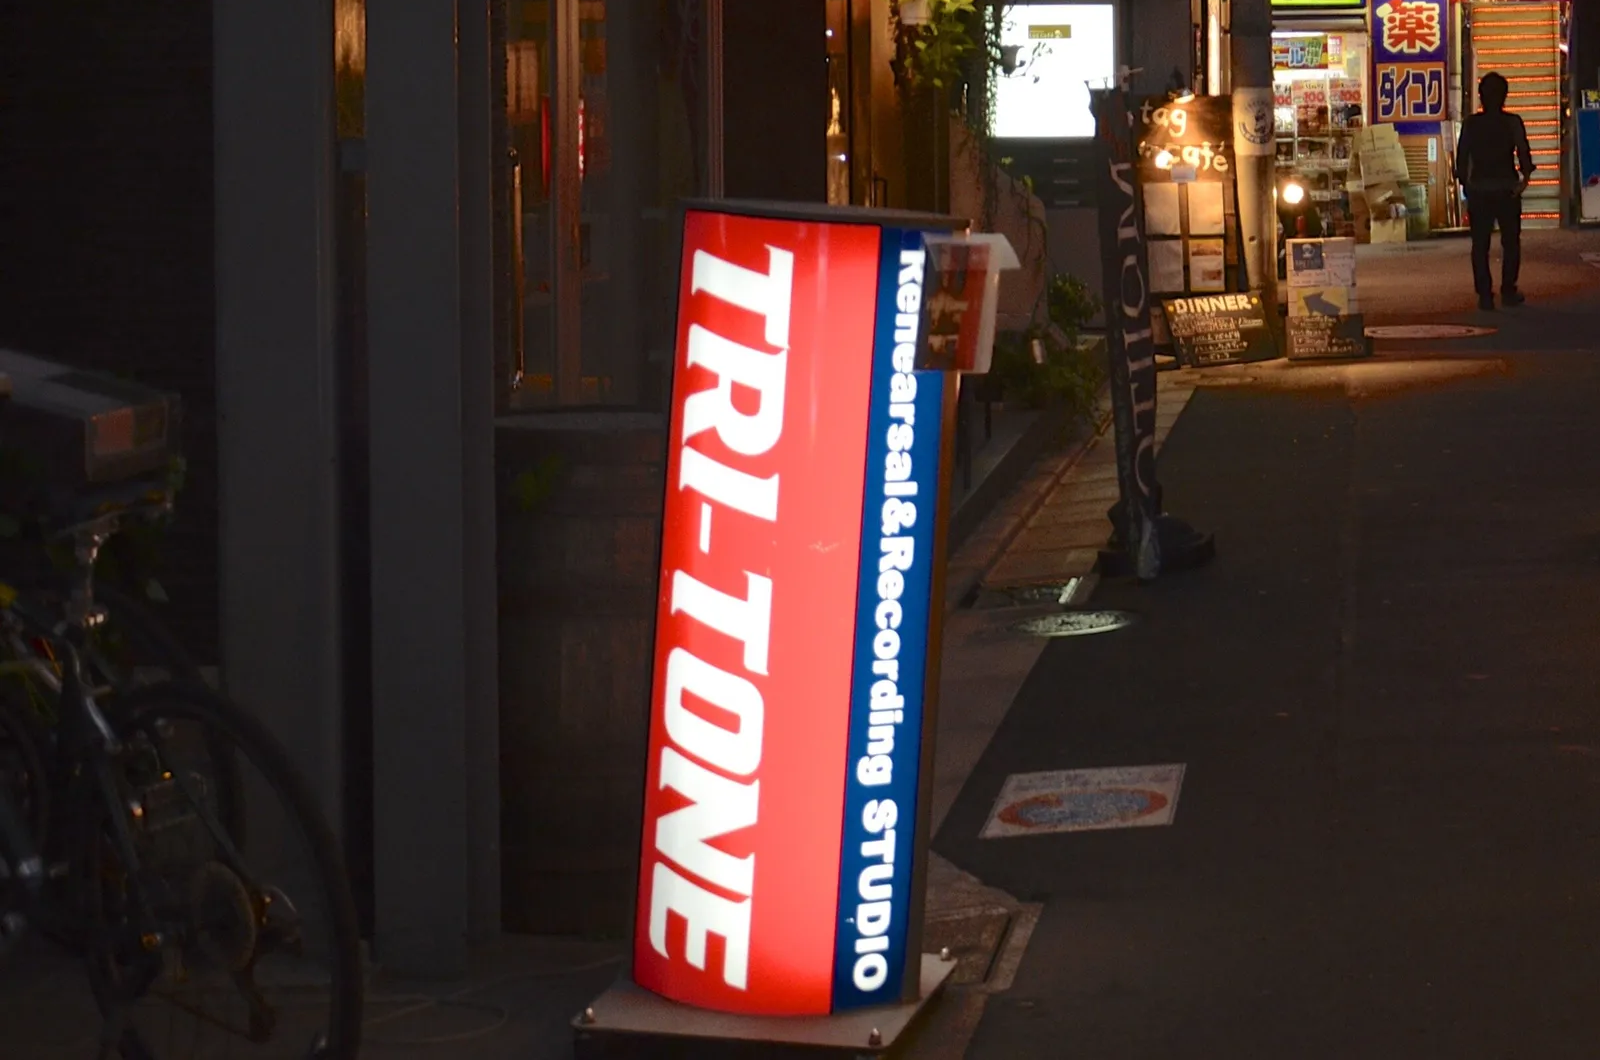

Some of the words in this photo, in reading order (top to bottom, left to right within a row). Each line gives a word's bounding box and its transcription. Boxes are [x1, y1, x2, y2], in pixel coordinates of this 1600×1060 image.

[1383, 0, 1441, 54] 薬
[1378, 67, 1445, 117] ダイコク
[1140, 99, 1188, 138] tag
[1173, 294, 1252, 315] DINNER
[649, 243, 795, 991] TRI-TONE
[853, 797, 899, 995] STUDIO
